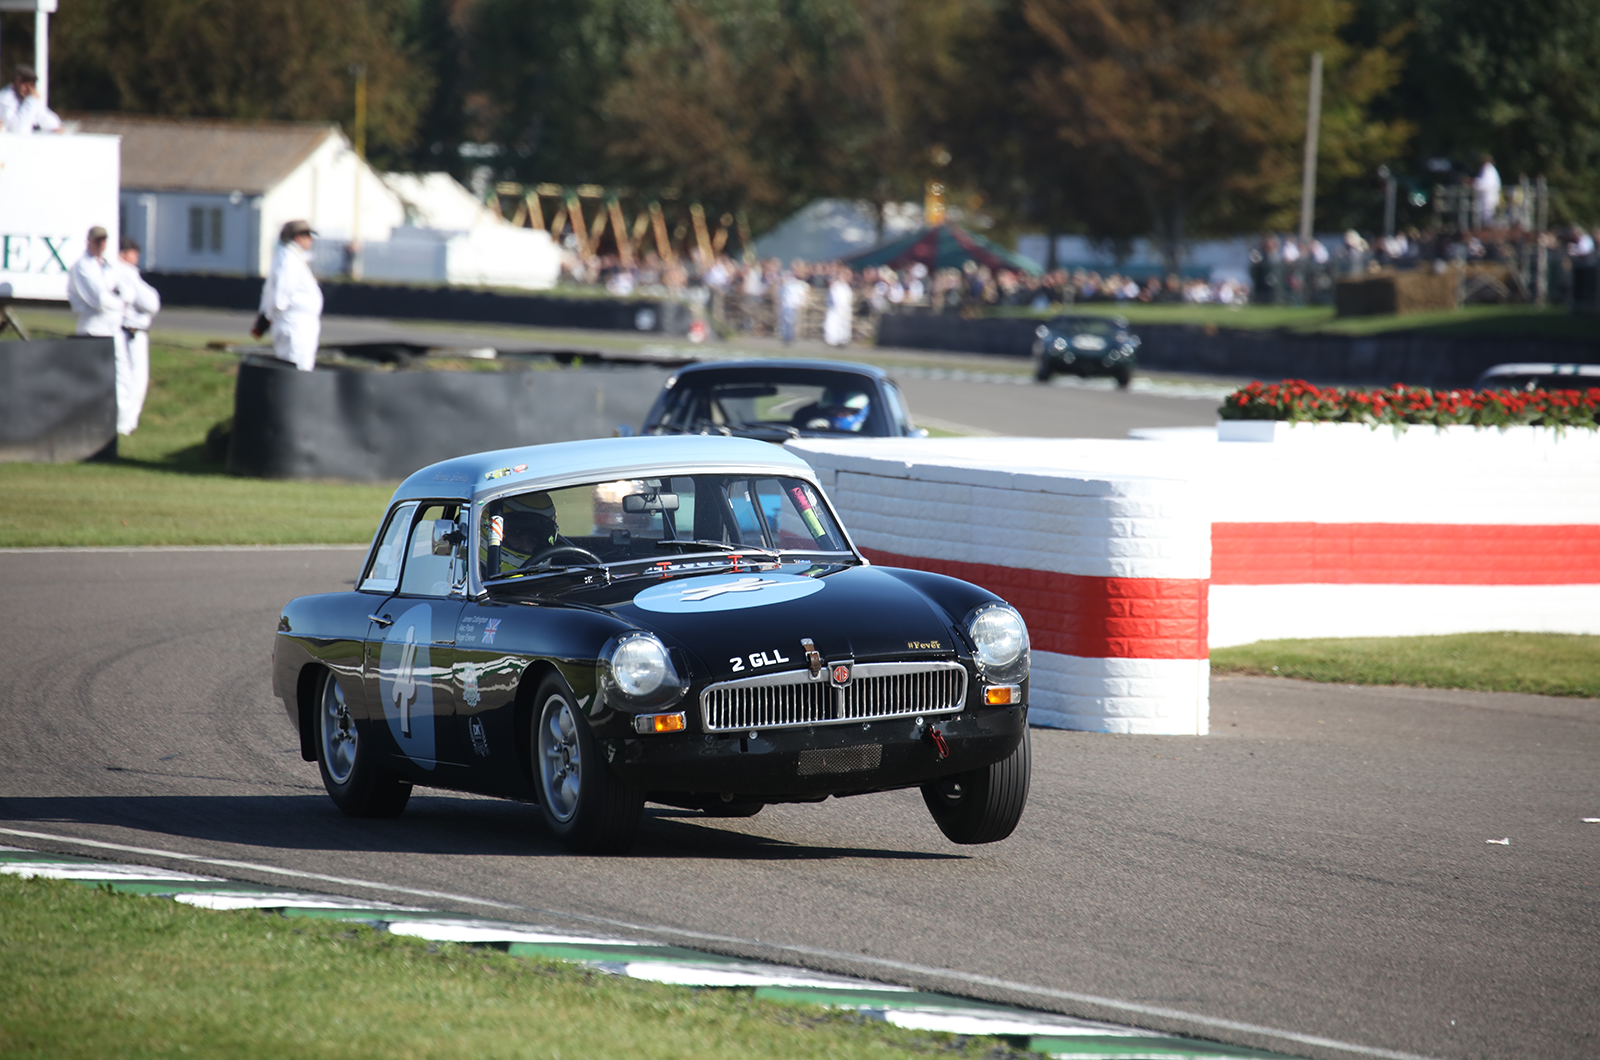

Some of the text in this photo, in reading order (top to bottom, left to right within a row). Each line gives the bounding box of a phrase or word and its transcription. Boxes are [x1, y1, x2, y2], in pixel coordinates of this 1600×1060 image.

[730, 650, 790, 673] 2 GLL
[392, 625, 416, 736] 4
[835, 667, 848, 681] MG
